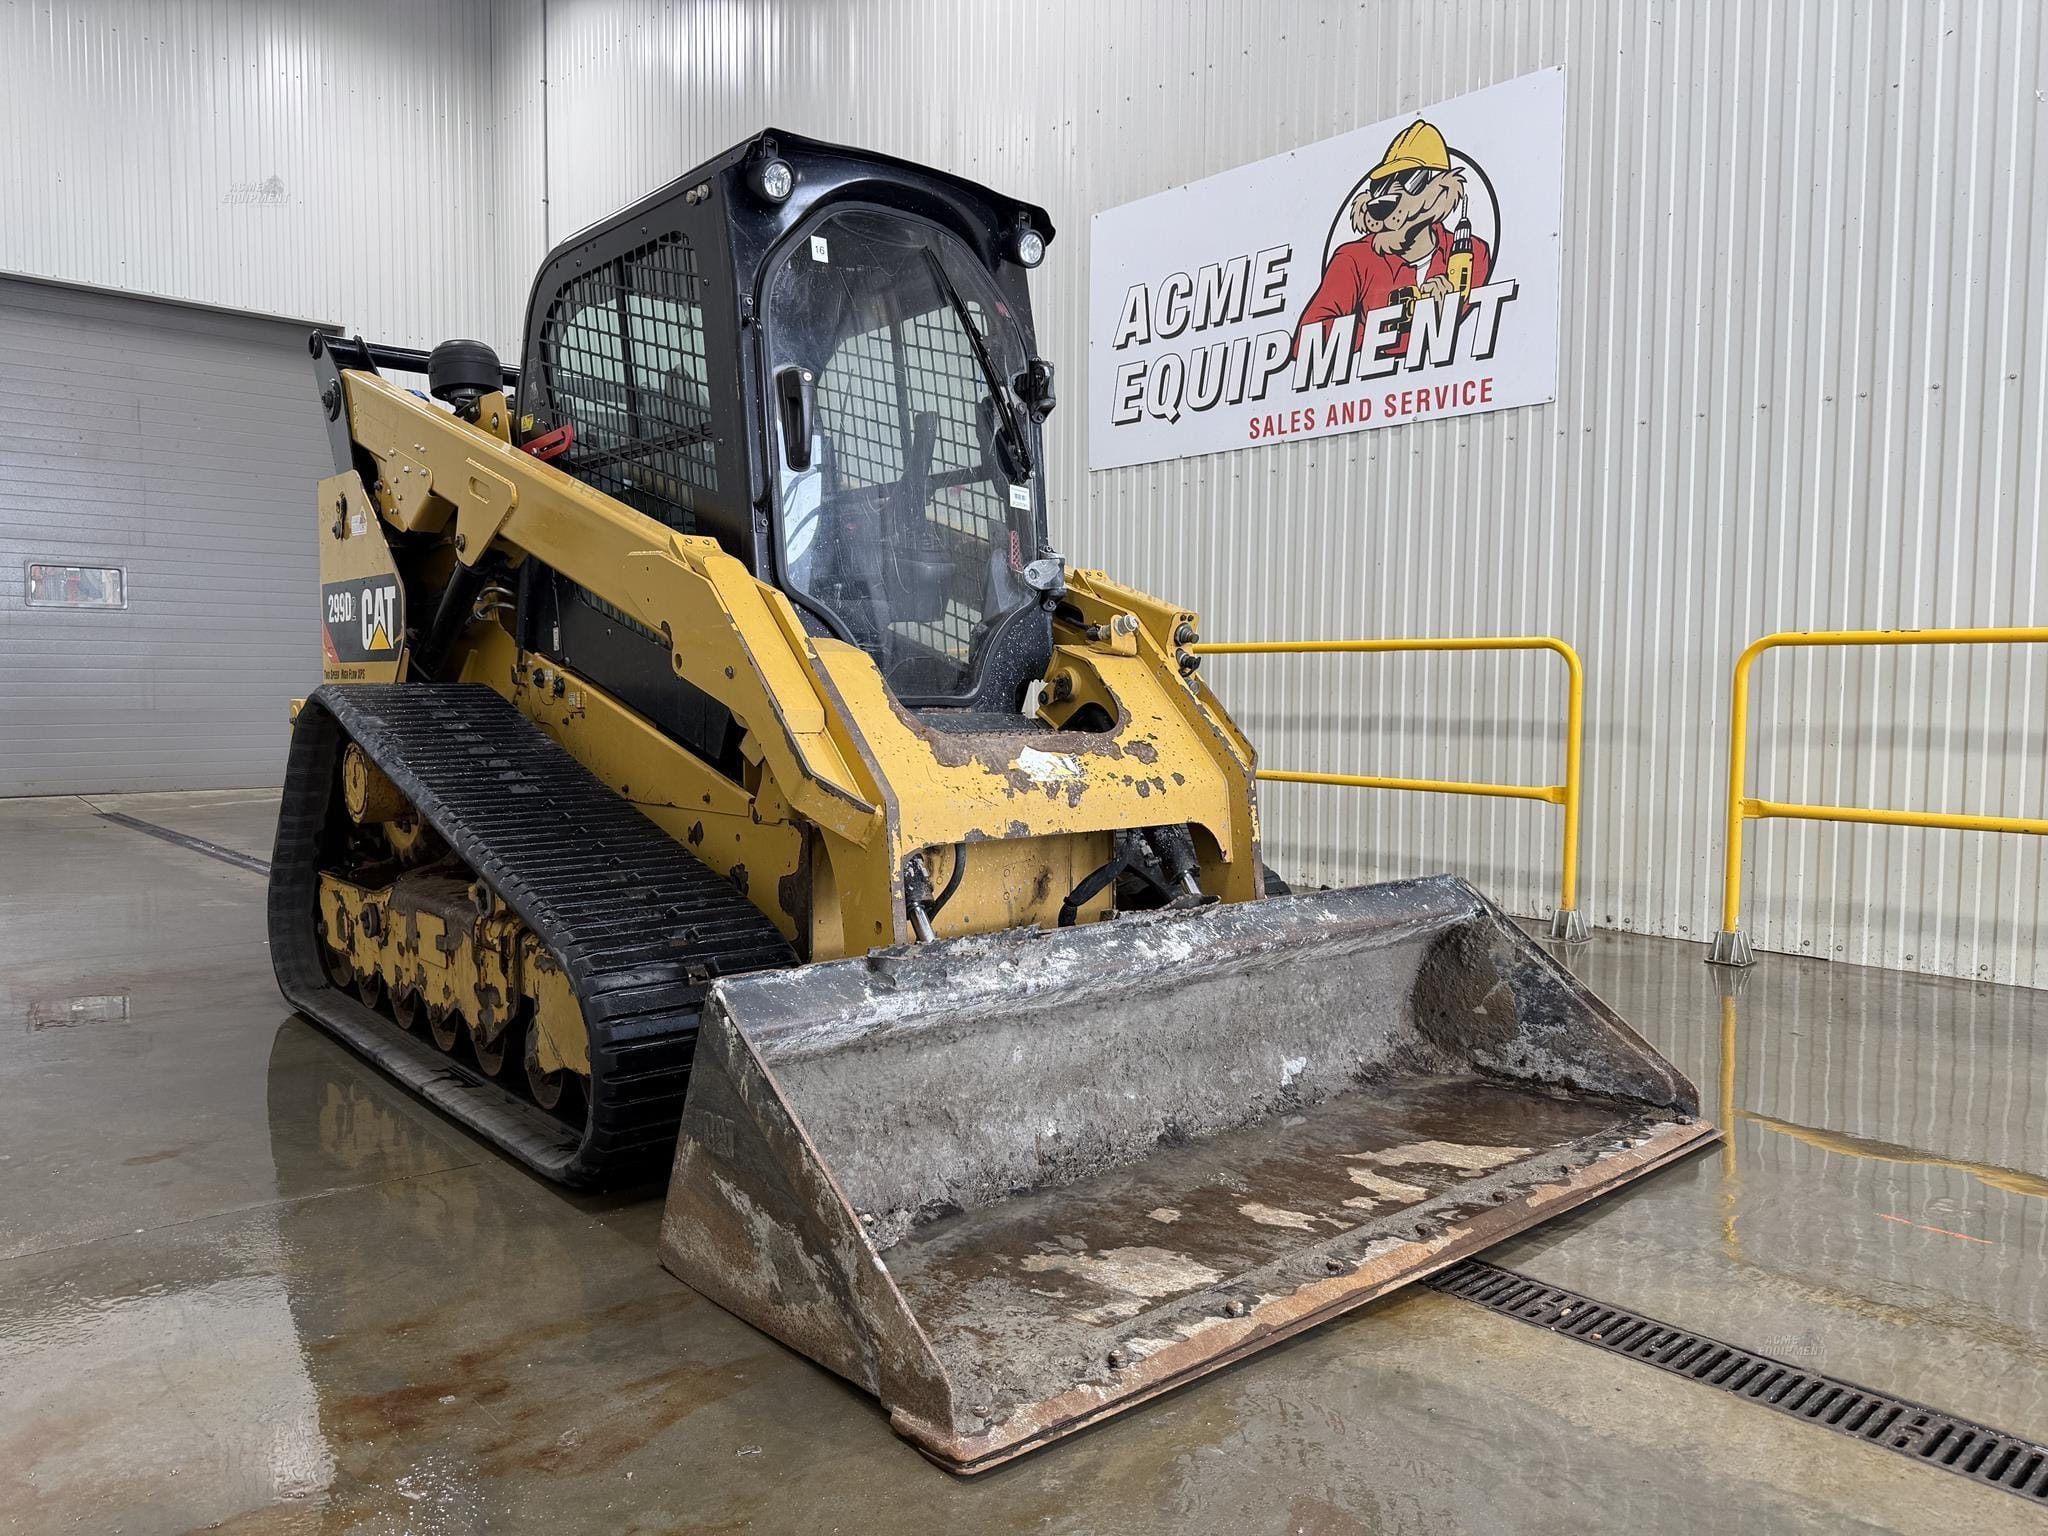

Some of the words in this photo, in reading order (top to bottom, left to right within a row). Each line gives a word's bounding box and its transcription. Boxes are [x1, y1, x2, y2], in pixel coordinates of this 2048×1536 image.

[815, 245, 825, 255] 16
[1112, 243, 1293, 350] ACME
[1111, 279, 1519, 427] EQUIPMENT
[1248, 407, 1316, 440] SALES
[1326, 397, 1372, 427] AND
[1384, 377, 1494, 418] SERVICE
[361, 586, 396, 650] CAT
